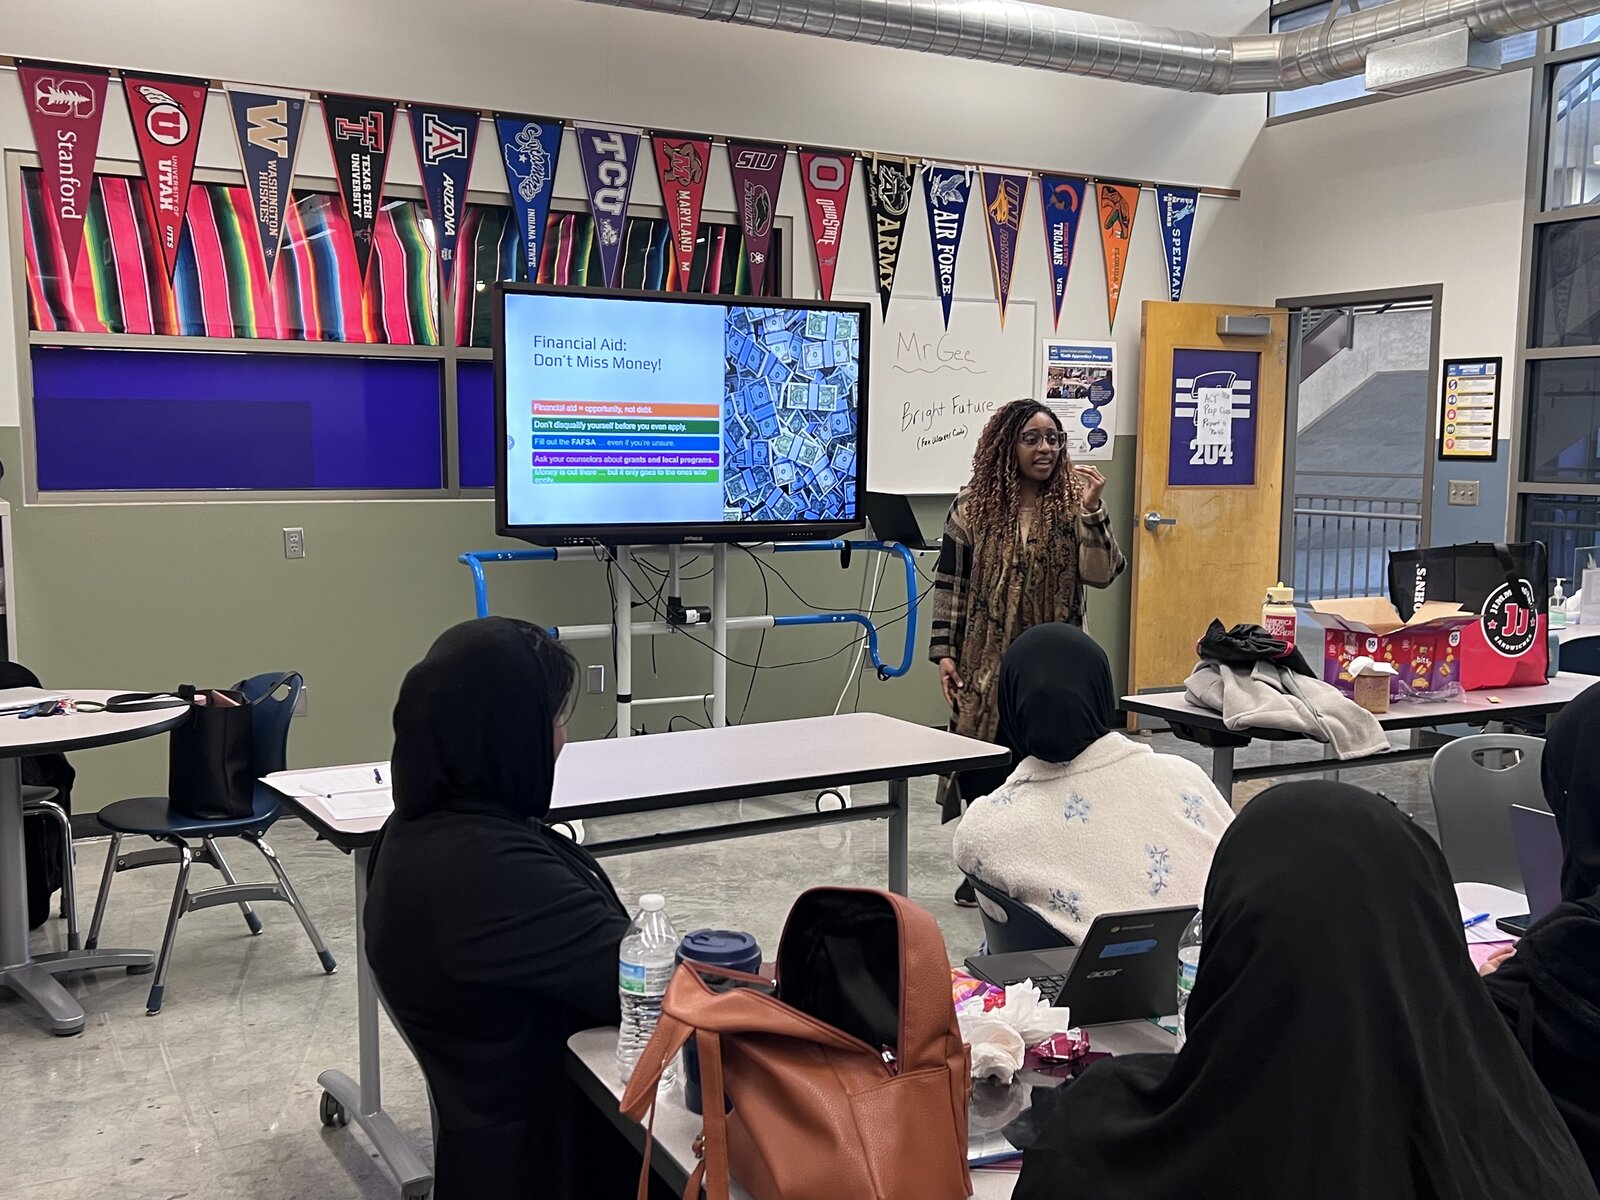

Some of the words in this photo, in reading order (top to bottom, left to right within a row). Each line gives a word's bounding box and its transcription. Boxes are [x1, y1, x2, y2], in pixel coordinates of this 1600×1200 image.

[150, 111, 181, 140] U
[246, 100, 288, 158] W
[422, 113, 467, 165] A
[57, 129, 82, 220] Stanford
[362, 154, 372, 190] TEXAS
[591, 132, 628, 216] TCU
[735, 150, 778, 171] SIU
[808, 154, 846, 192] O
[158, 159, 174, 211] UTAH
[171, 154, 179, 204] UNIVERSITY
[350, 153, 362, 218] UNIVERSITY
[174, 205, 180, 217] OF
[258, 171, 269, 224] HUSKIES
[267, 160, 279, 237] WASHINGTON
[364, 192, 373, 219] TECH
[442, 172, 456, 236] ARIZONA
[1003, 178, 1020, 231] UNI
[166, 225, 174, 249] UTES
[527, 208, 536, 240] INDIANA
[679, 190, 692, 252] MARYLAND
[933, 208, 959, 239] AIR
[528, 241, 537, 268] STATE
[876, 213, 901, 292] ARMY
[1000, 228, 1009, 294] PANTHERS
[1053, 222, 1063, 265] TROJANS
[681, 261, 690, 271] M
[937, 243, 955, 294] FORCE
[1172, 228, 1181, 298] SPELMAN
[533, 335, 597, 350] Financial
[600, 338, 627, 351] Aid:
[896, 332, 932, 361] Mr
[937, 333, 976, 363] Gee
[534, 353, 574, 367] Don't
[577, 355, 609, 369] Miss
[612, 356, 662, 374] Money!
[533, 403, 565, 411] Financial
[566, 404, 577, 412] aid
[901, 401, 946, 432] Bright
[952, 395, 997, 414] Future
[534, 420, 553, 428] Don't
[553, 420, 586, 430] disqualify
[587, 421, 614, 431] yourself
[614, 421, 636, 430] before
[667, 423, 687, 432] apply.
[546, 438, 558, 446] out
[558, 438, 571, 446] the
[571, 438, 597, 446] FAFSA
[549, 456, 565, 464] your
[603, 455, 623, 463] about
[623, 456, 647, 465] grants
[679, 457, 714, 465] programs.
[1189, 438, 1233, 465] 204
[1413, 567, 1426, 612] OHN'S
[1489, 589, 1513, 614] JIMM
[1501, 602, 1530, 637] JJ
[1493, 633, 1533, 651] SANDWICHES
[1086, 968, 1123, 979] acer
